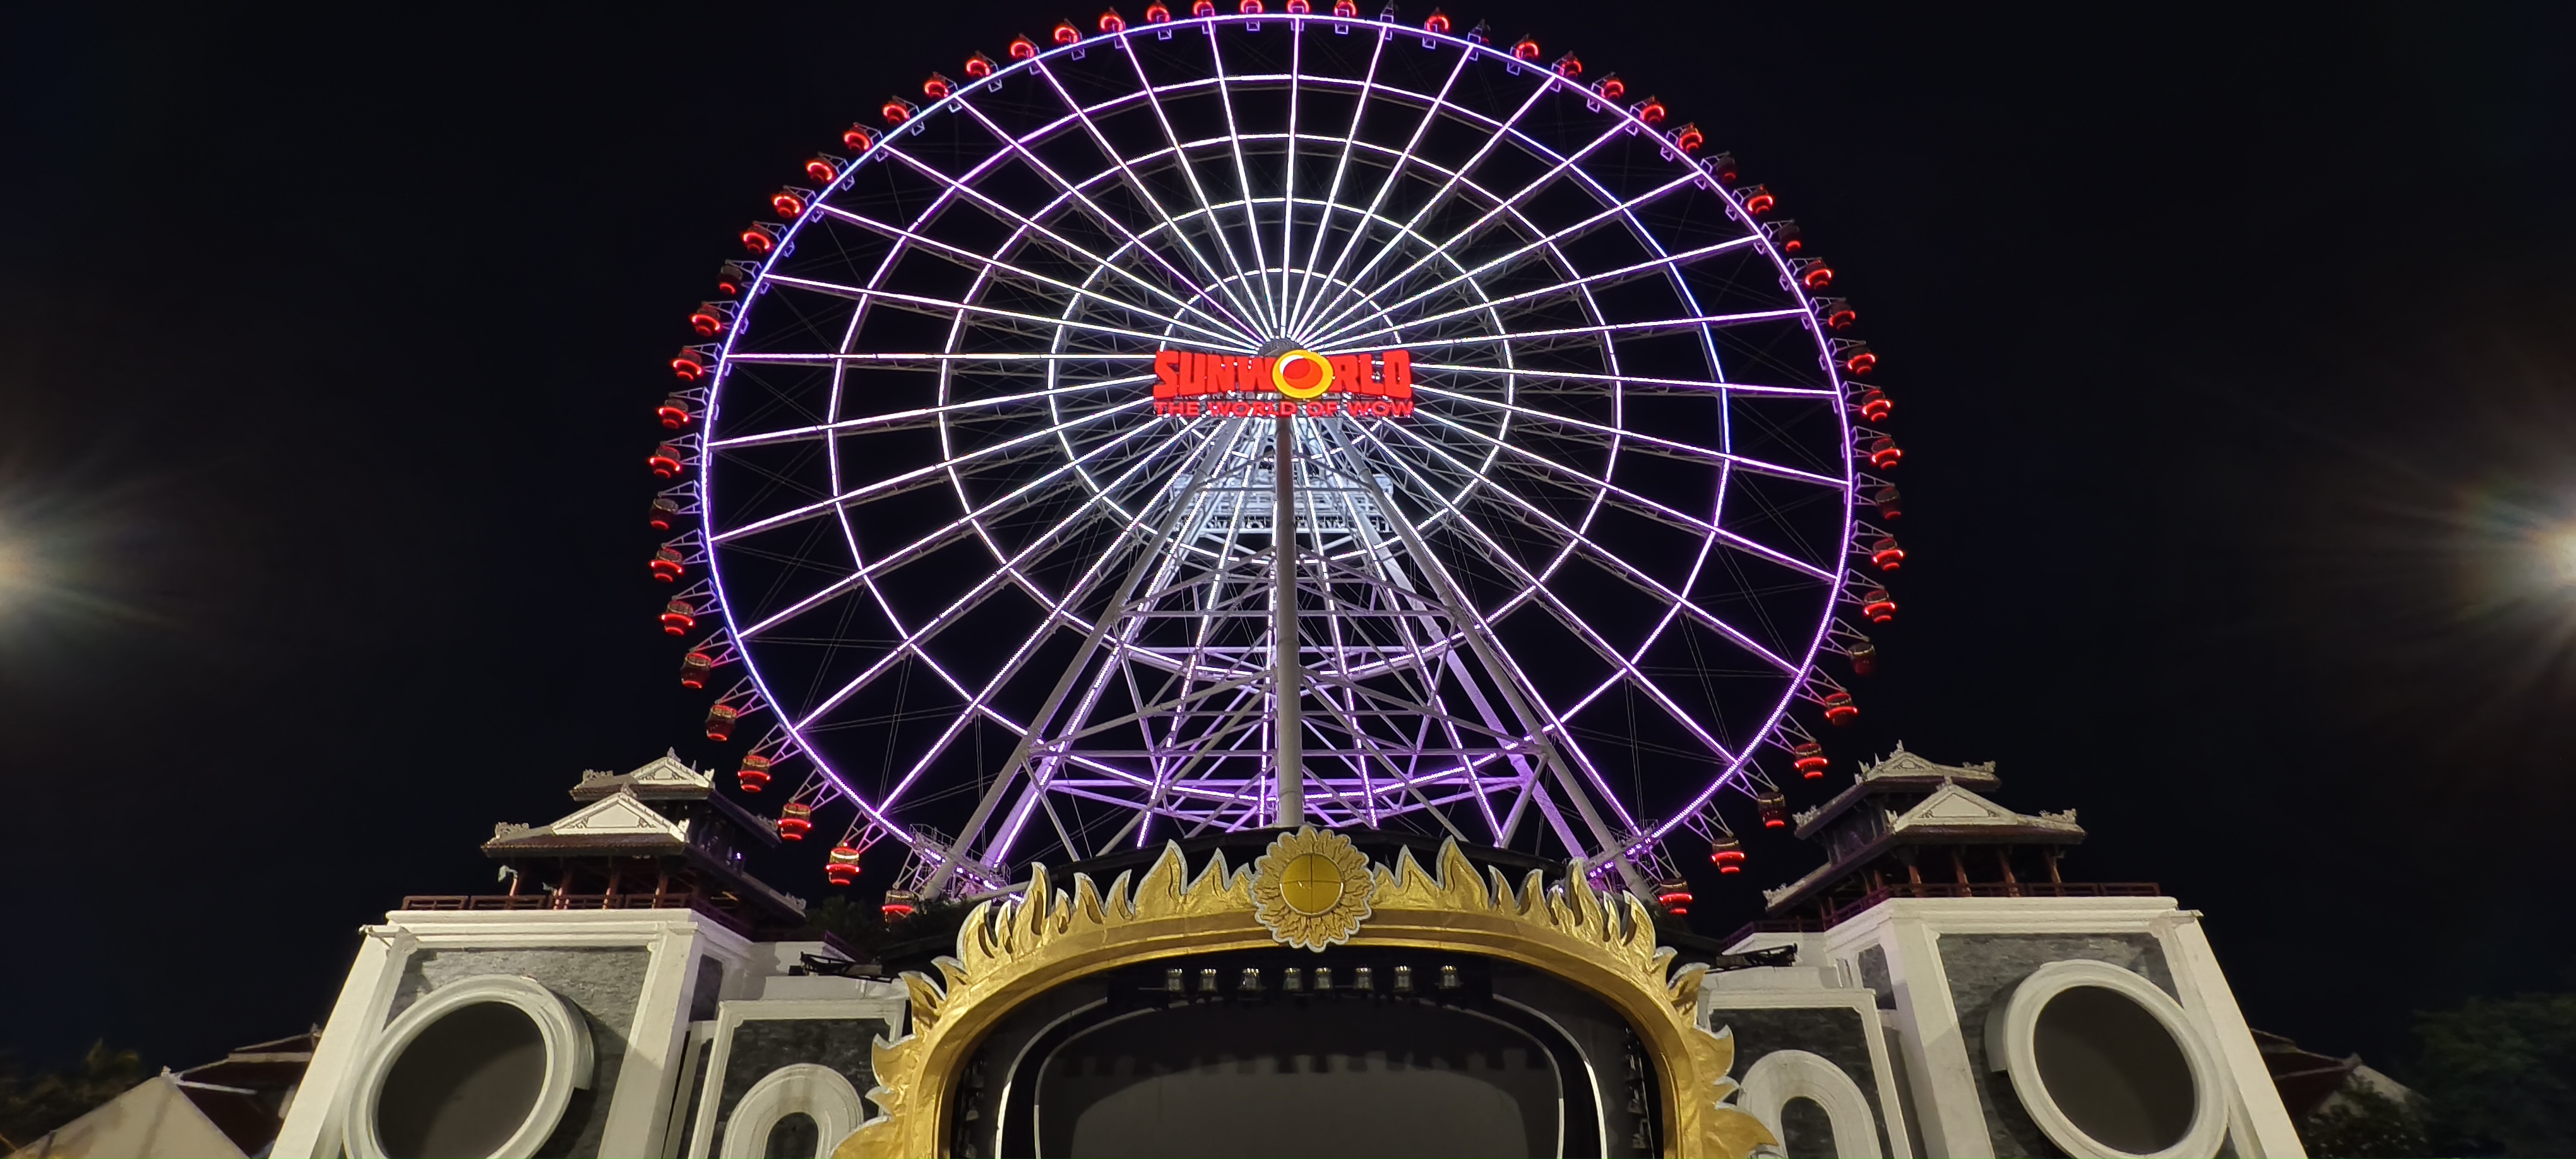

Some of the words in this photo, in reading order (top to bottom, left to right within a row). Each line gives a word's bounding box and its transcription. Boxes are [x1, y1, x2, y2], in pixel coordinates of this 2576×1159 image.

[1154, 401, 1200, 416] THE
[1207, 401, 1297, 417] WORLD
[1306, 401, 1338, 416] OF
[1347, 401, 1414, 417] WOW
